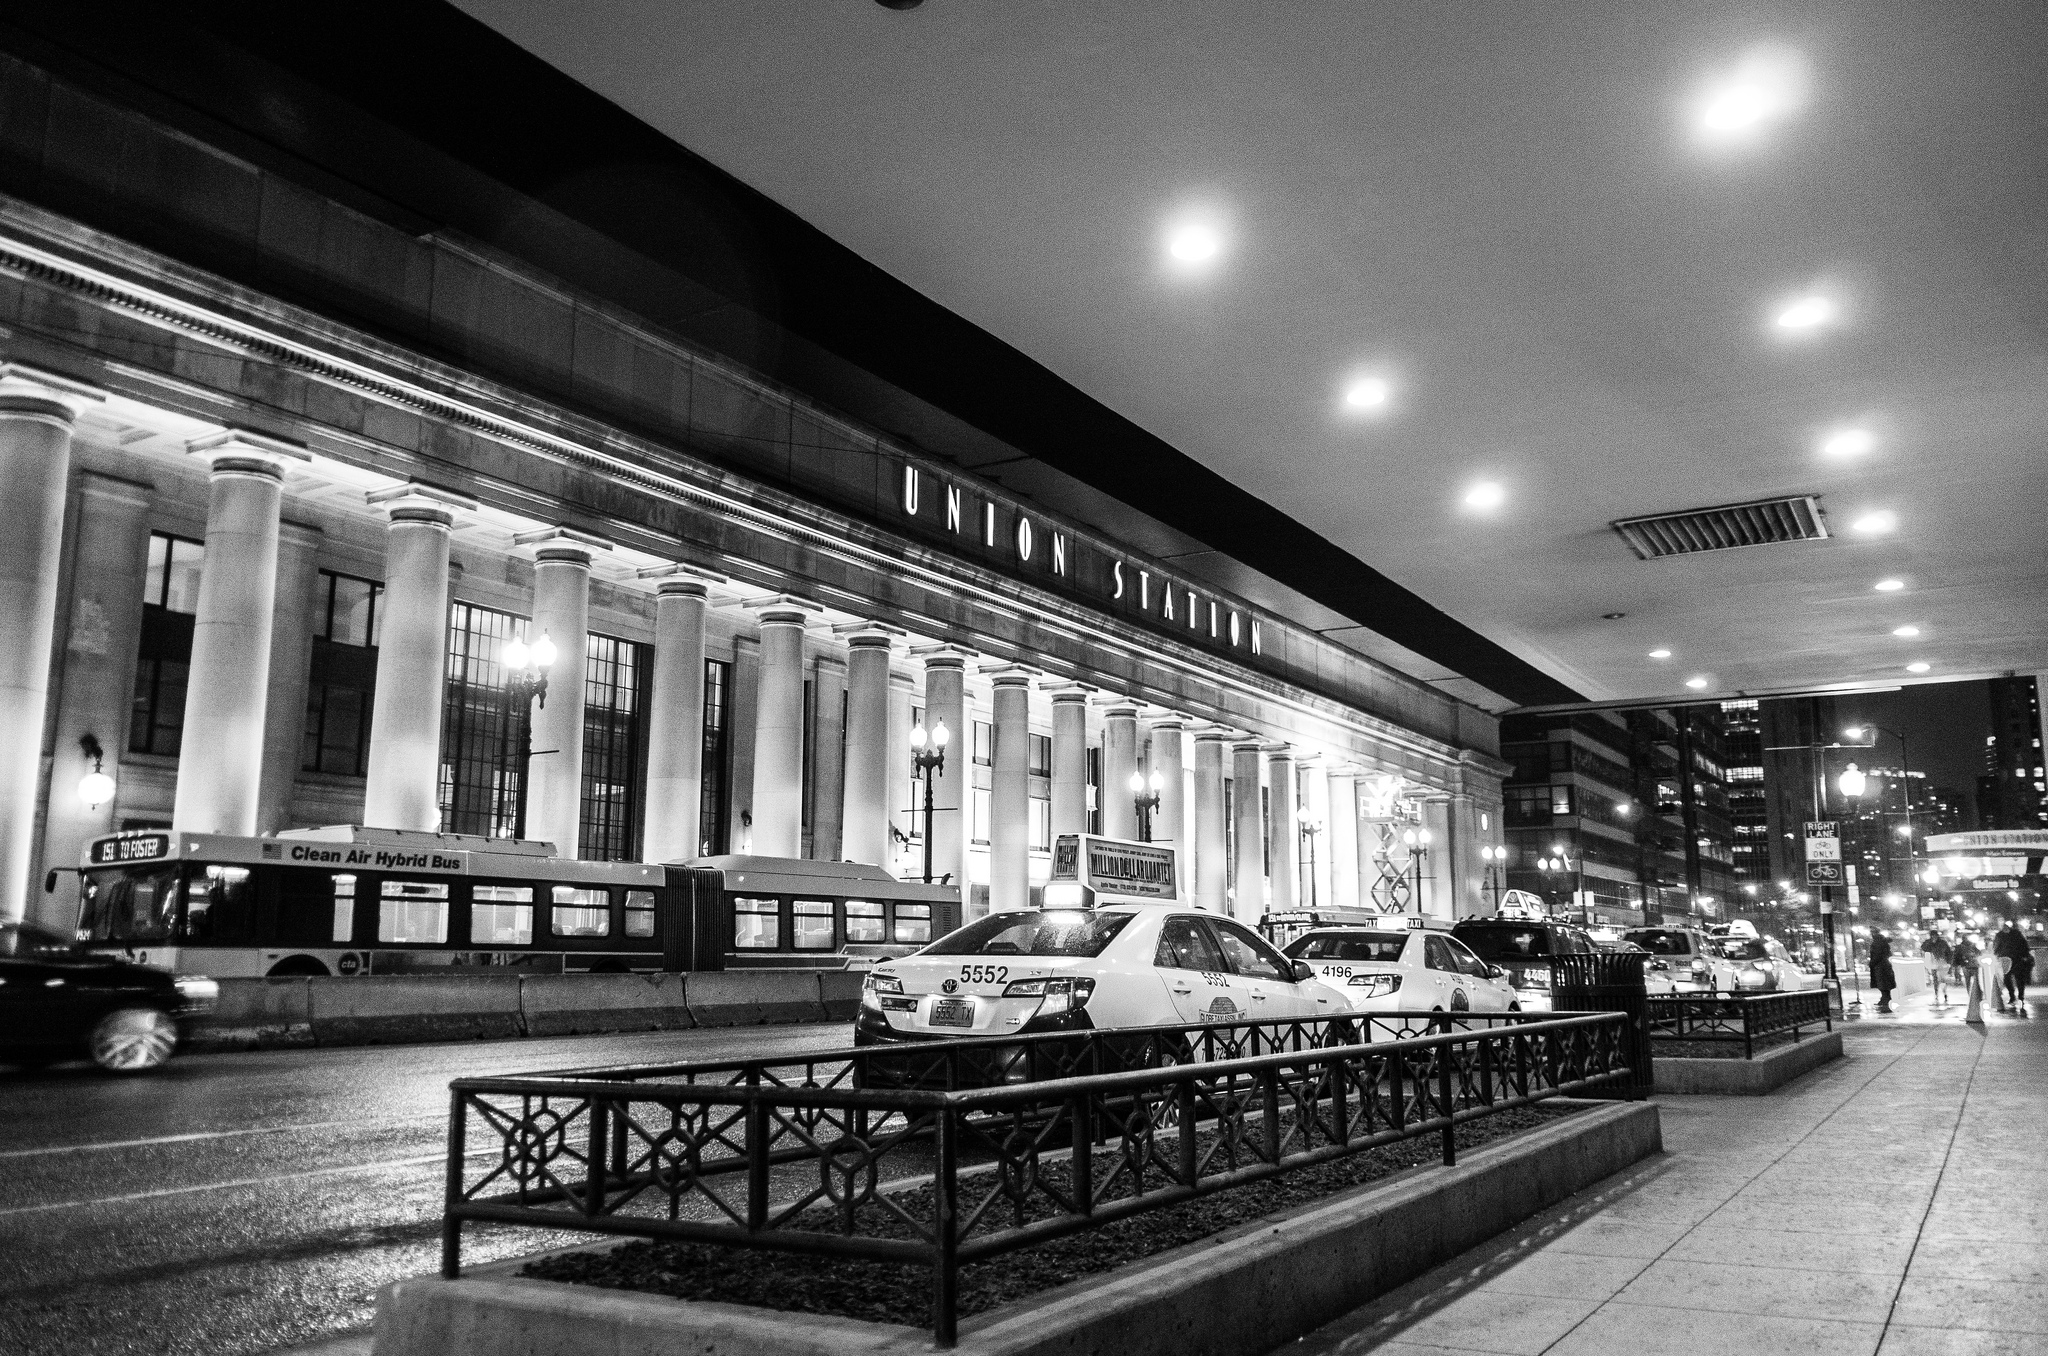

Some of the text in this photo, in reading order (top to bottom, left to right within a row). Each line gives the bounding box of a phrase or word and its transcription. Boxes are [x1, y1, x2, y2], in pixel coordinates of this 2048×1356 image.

[905, 465, 1262, 656] UNION STATION
[1807, 822, 1836, 831] RIGHT
[1809, 830, 1835, 838] LANE
[102, 838, 158, 861] 151 TO FOSTER
[1813, 850, 1835, 858] ONLY
[290, 845, 461, 870] Clean Air Hybrid Bus
[1365, 919, 1378, 928] TAX
[1407, 919, 1421, 929] TAXI
[341, 960, 357, 969] cta
[959, 964, 1009, 985] 5552
[1322, 965, 1353, 978] 4196
[1523, 968, 1551, 982] 4460
[1201, 972, 1230, 988] 5552
[935, 1005, 973, 1020] 5552 TX
